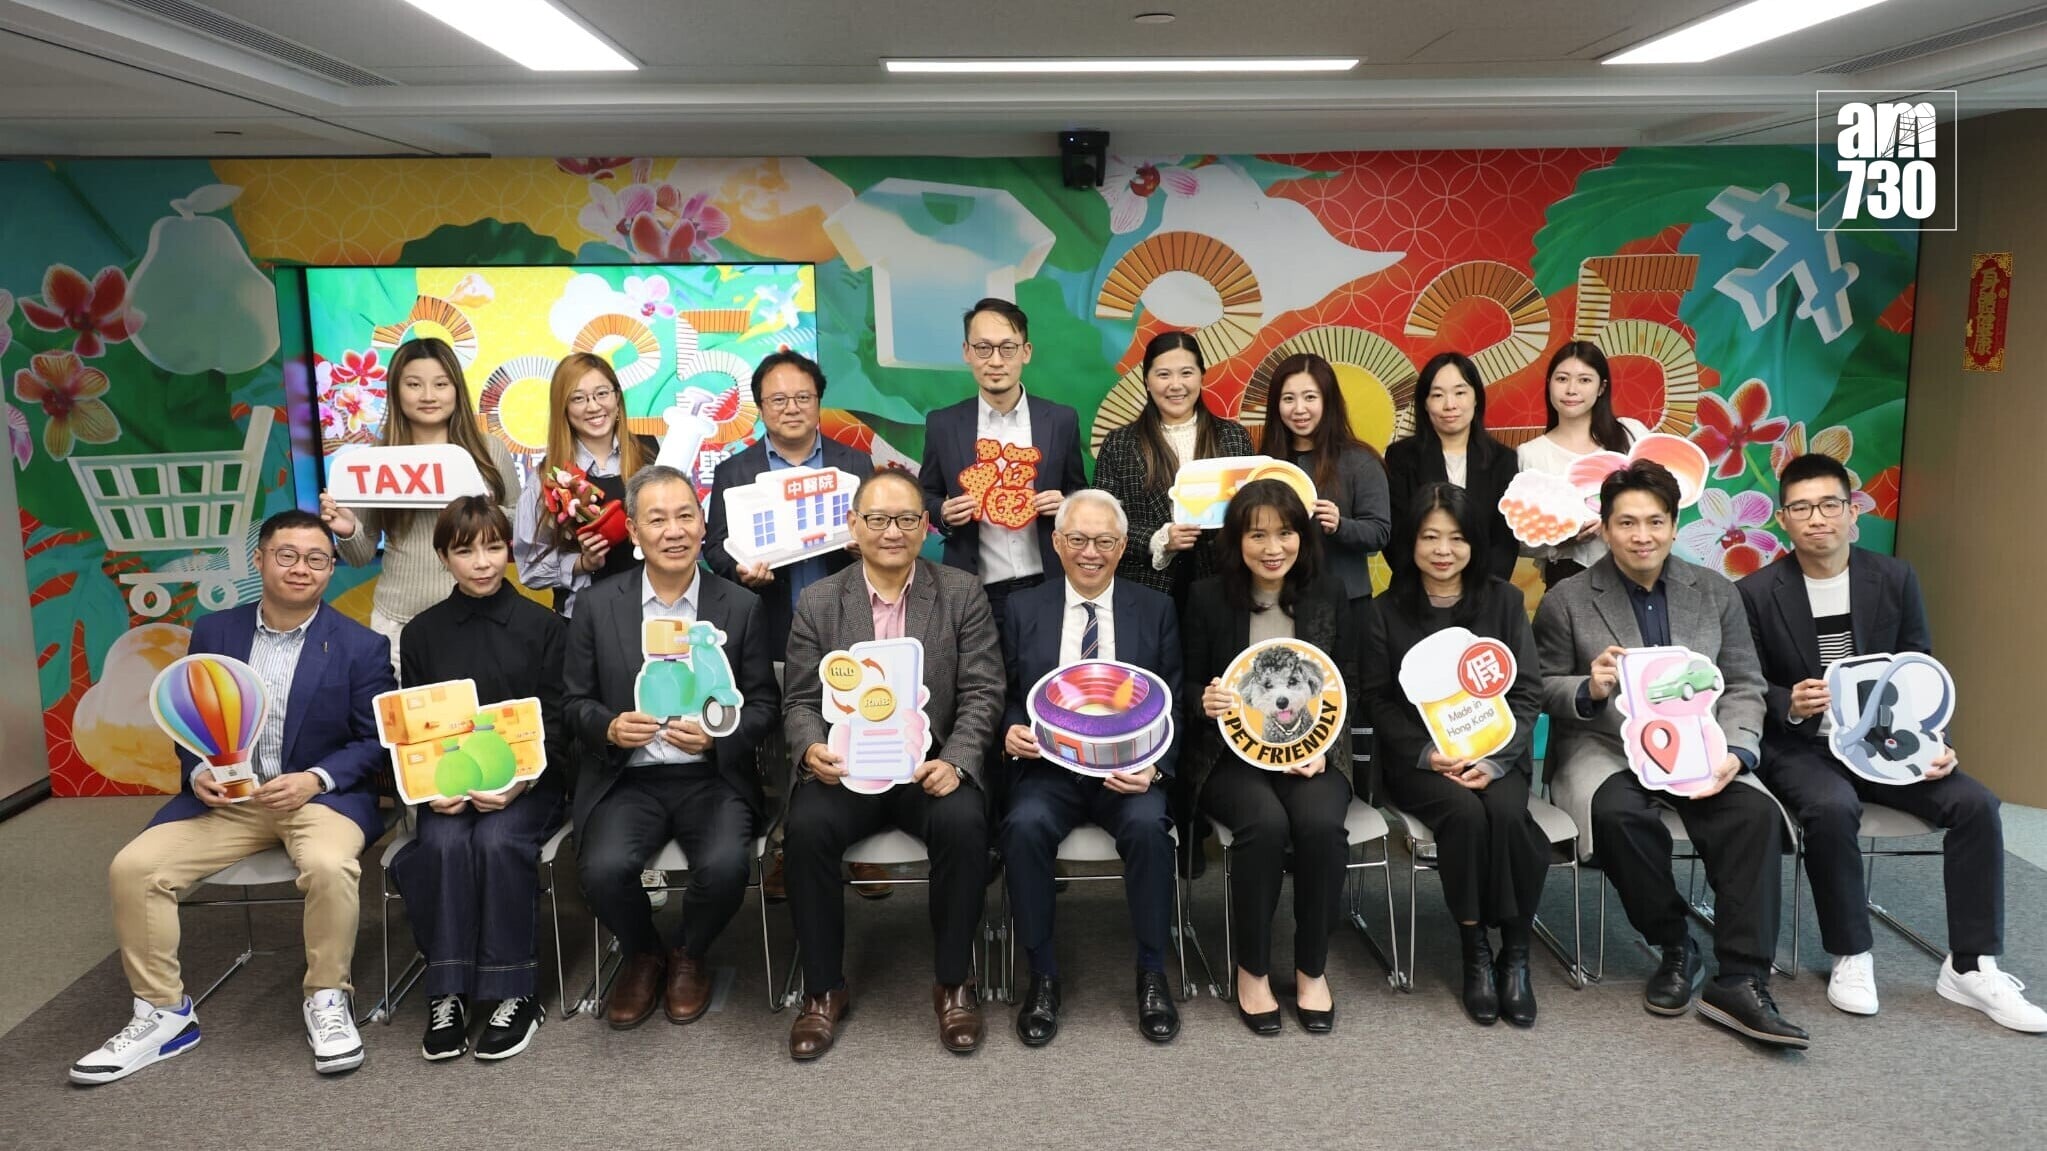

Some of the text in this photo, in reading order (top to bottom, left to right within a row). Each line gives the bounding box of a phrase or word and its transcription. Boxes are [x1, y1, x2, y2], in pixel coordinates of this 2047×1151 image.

[346, 463, 446, 495] TAXI
[786, 474, 835, 497] 中醫院
[1465, 649, 1505, 693] 假
[1446, 707, 1495, 737] Hong Kong
[1448, 699, 1483, 722] Made in
[1223, 699, 1338, 764] PET FRIENDLY
